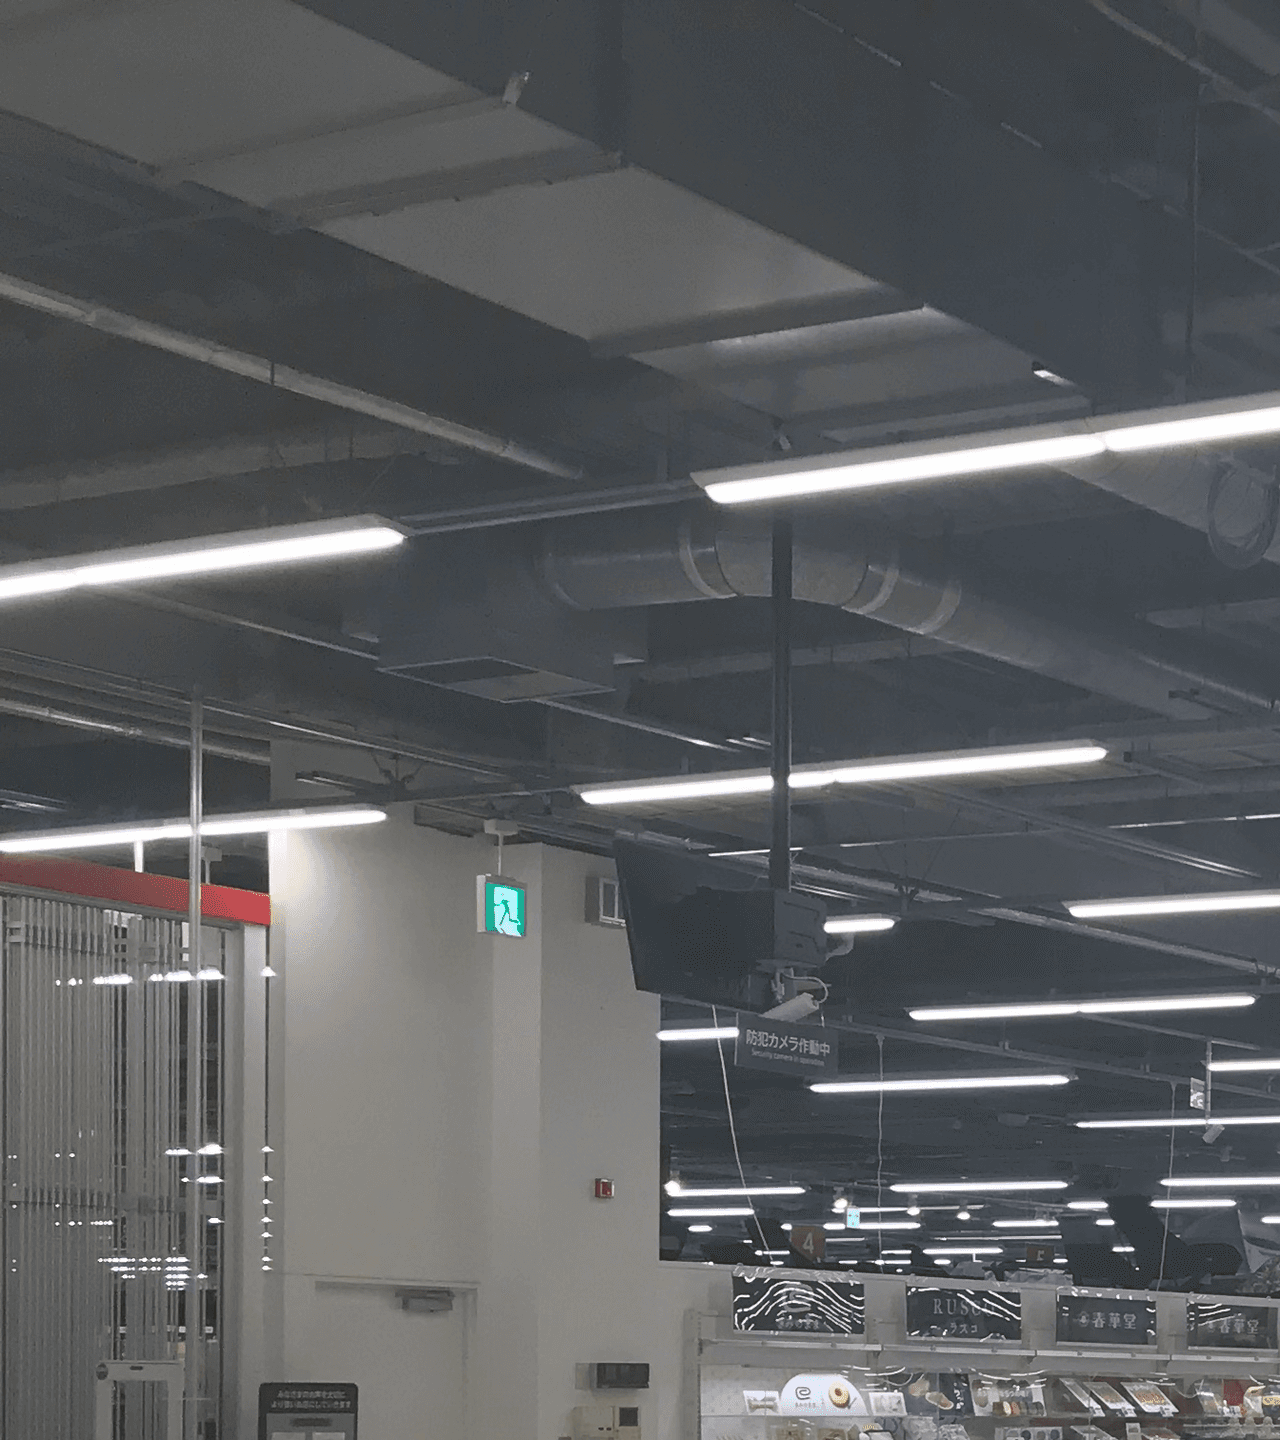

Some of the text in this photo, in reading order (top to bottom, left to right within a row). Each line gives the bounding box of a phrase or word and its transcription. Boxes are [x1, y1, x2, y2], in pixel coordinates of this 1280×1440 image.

[745, 1028, 831, 1057] 防犯カメラ作動中
